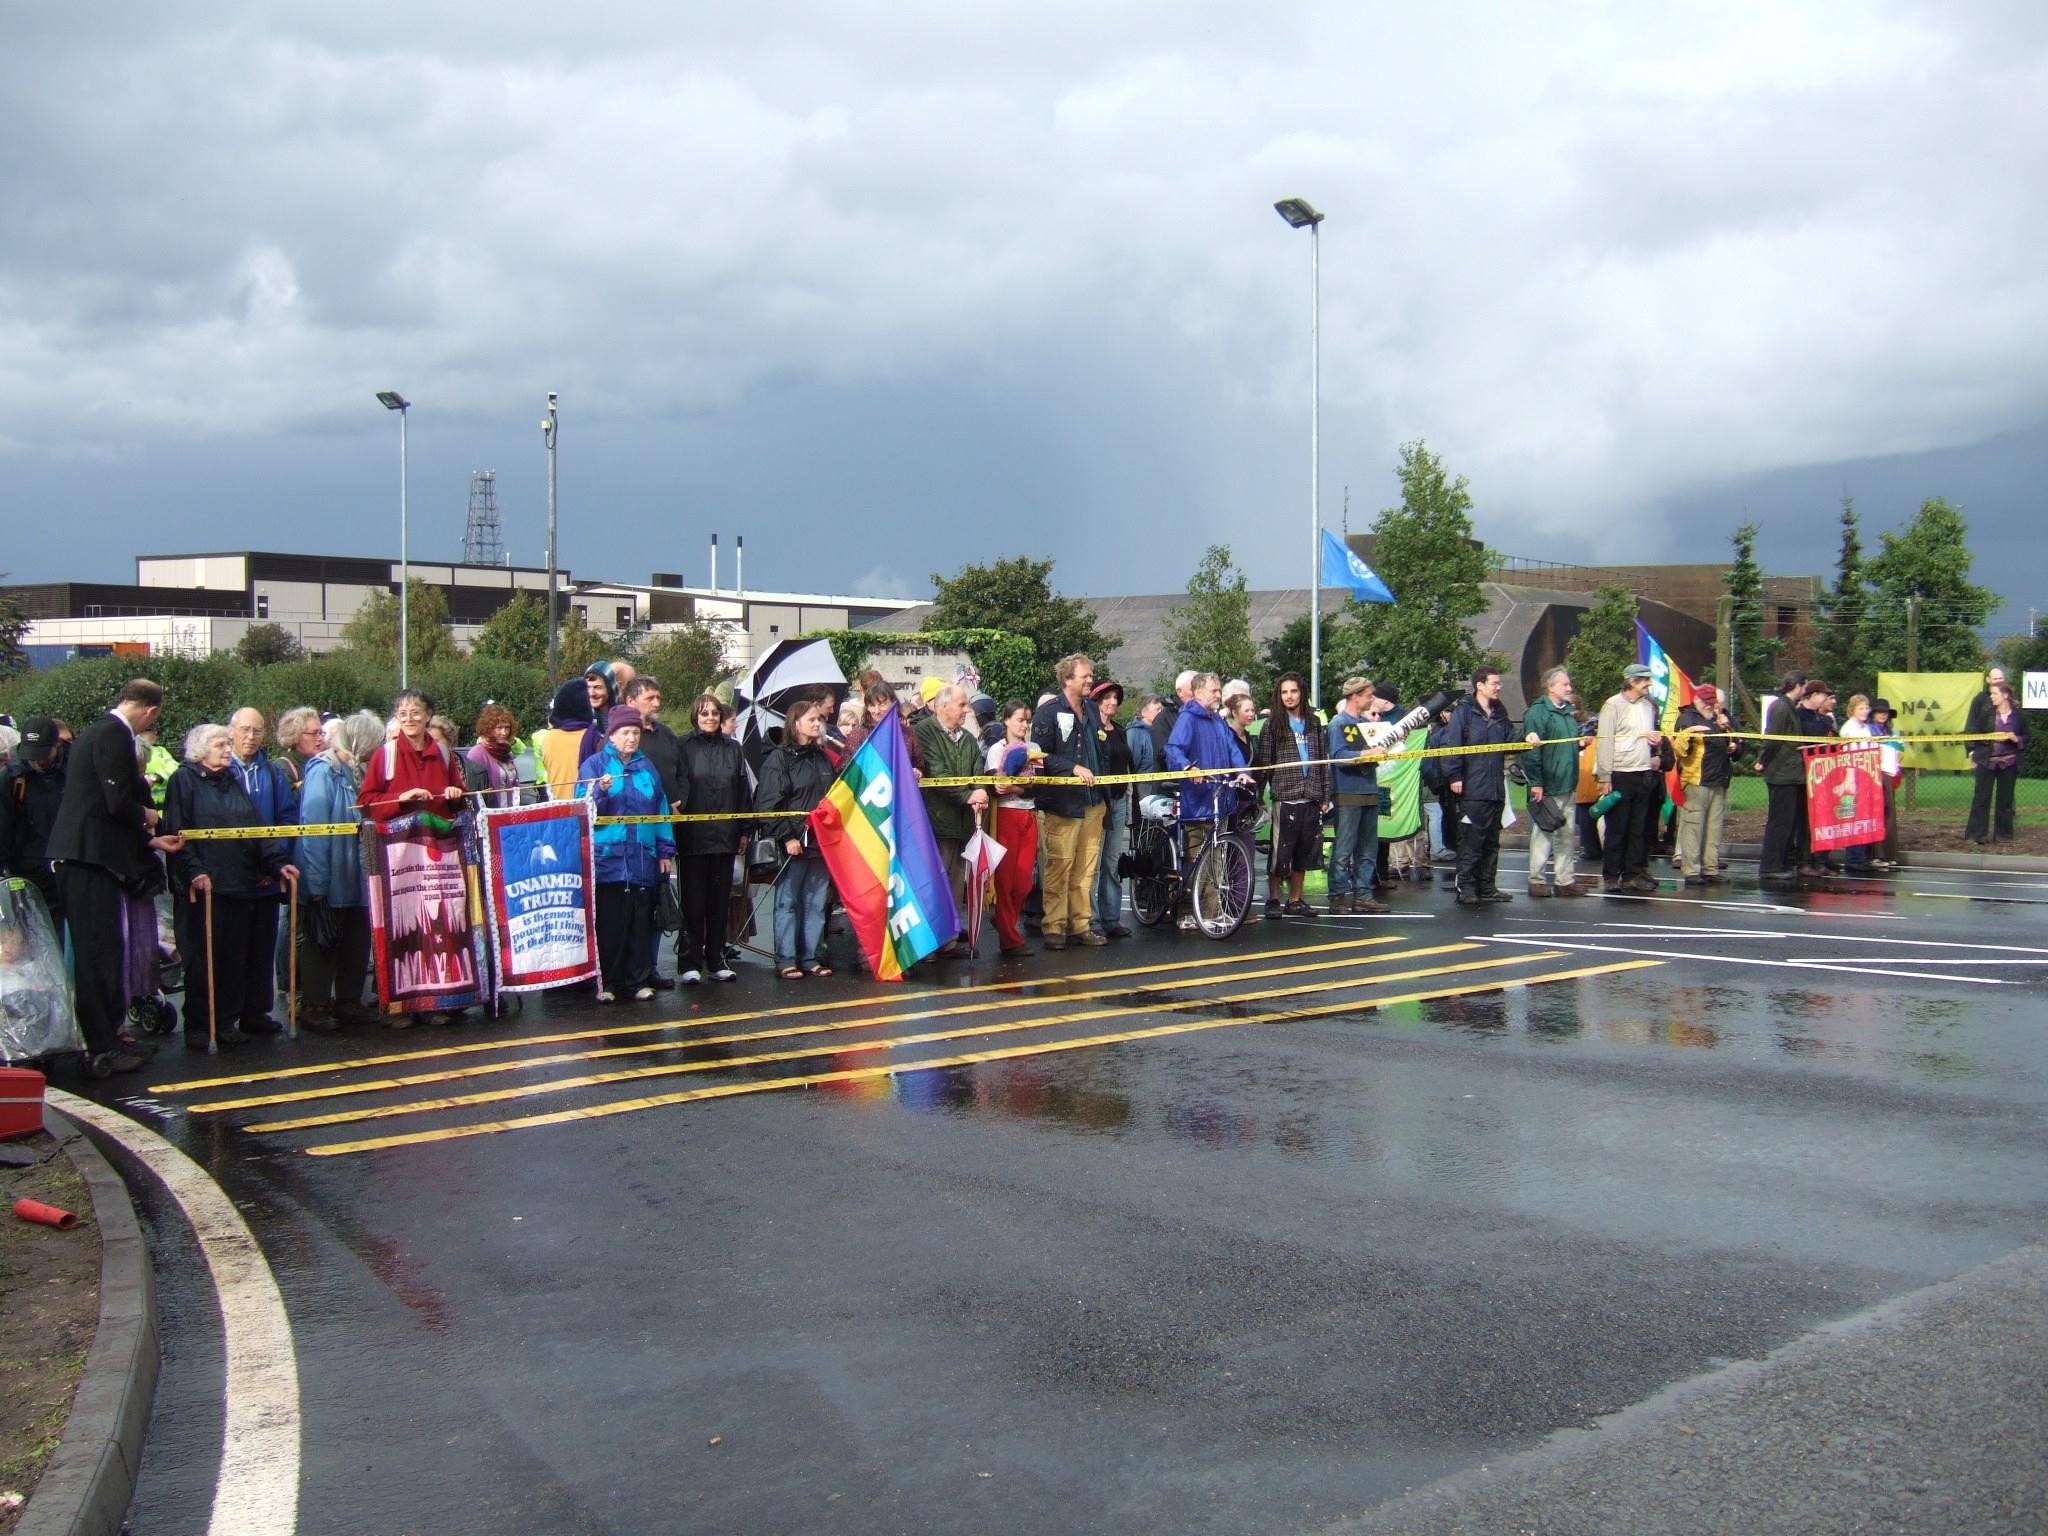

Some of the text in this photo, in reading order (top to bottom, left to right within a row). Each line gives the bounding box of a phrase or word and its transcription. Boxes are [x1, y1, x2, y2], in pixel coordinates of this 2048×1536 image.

[885, 646, 929, 656] FIGHTER
[904, 666, 921, 675] THE
[1400, 708, 1430, 741] NUKE
[1837, 753, 1851, 767] FOR
[1853, 750, 1882, 786] PEACE
[505, 873, 583, 898] UNARMED
[520, 890, 574, 912] TRUTH
[522, 909, 575, 925] is the most
[512, 920, 585, 944] powerful thing
[514, 932, 585, 954] in the Universe
